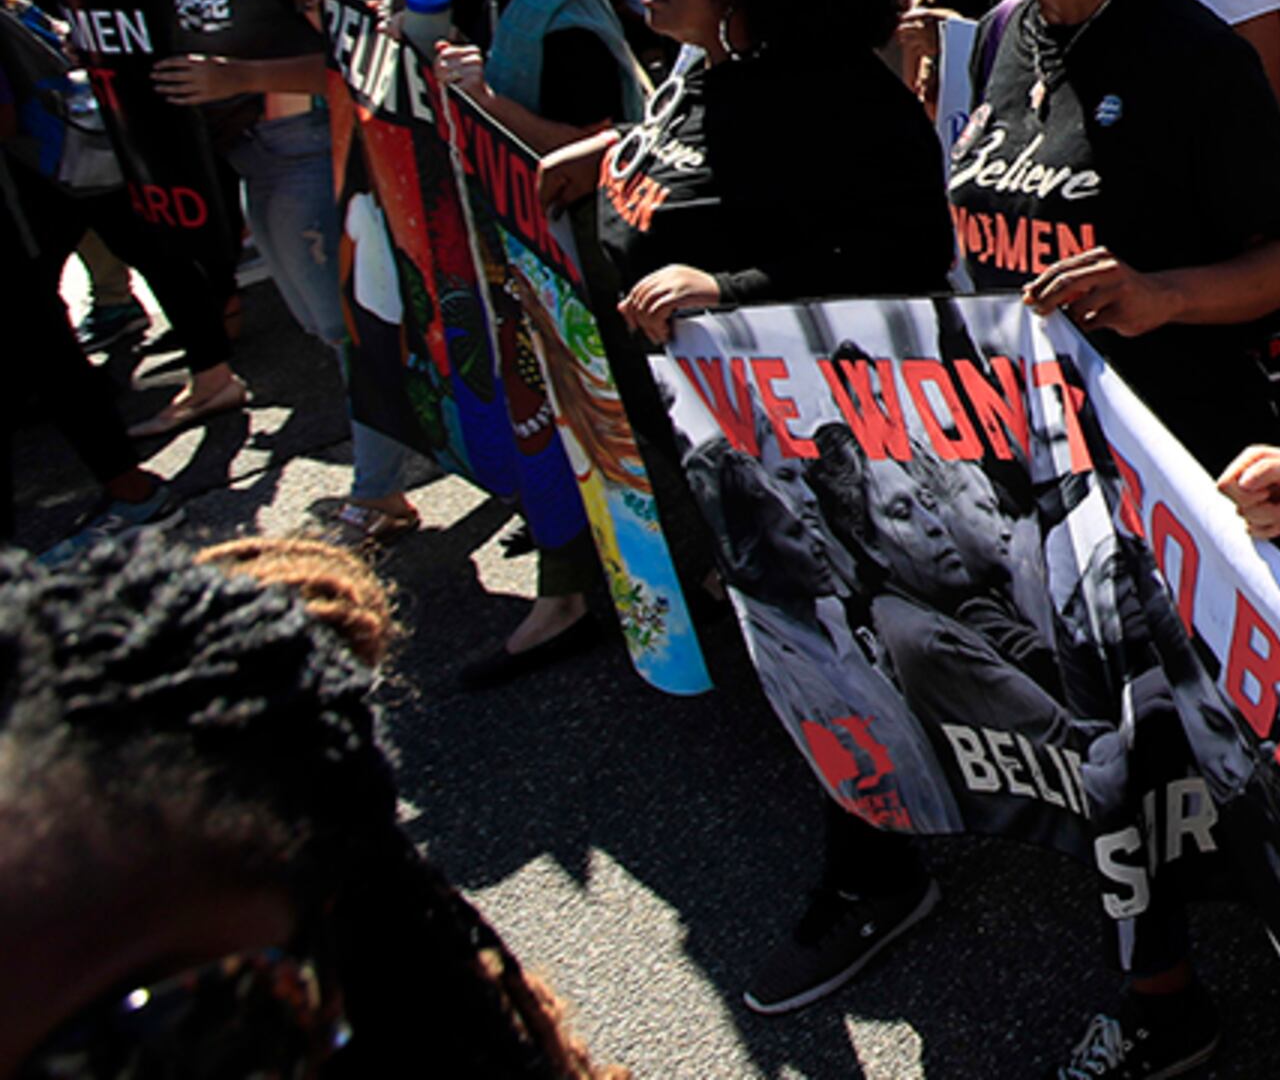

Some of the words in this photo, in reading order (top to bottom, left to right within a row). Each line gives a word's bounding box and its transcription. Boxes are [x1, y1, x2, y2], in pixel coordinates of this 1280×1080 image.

[69, 10, 154, 54] MEN
[949, 128, 1101, 200] Believe
[678, 357, 820, 460] WE
[941, 723, 1092, 819] BELI
